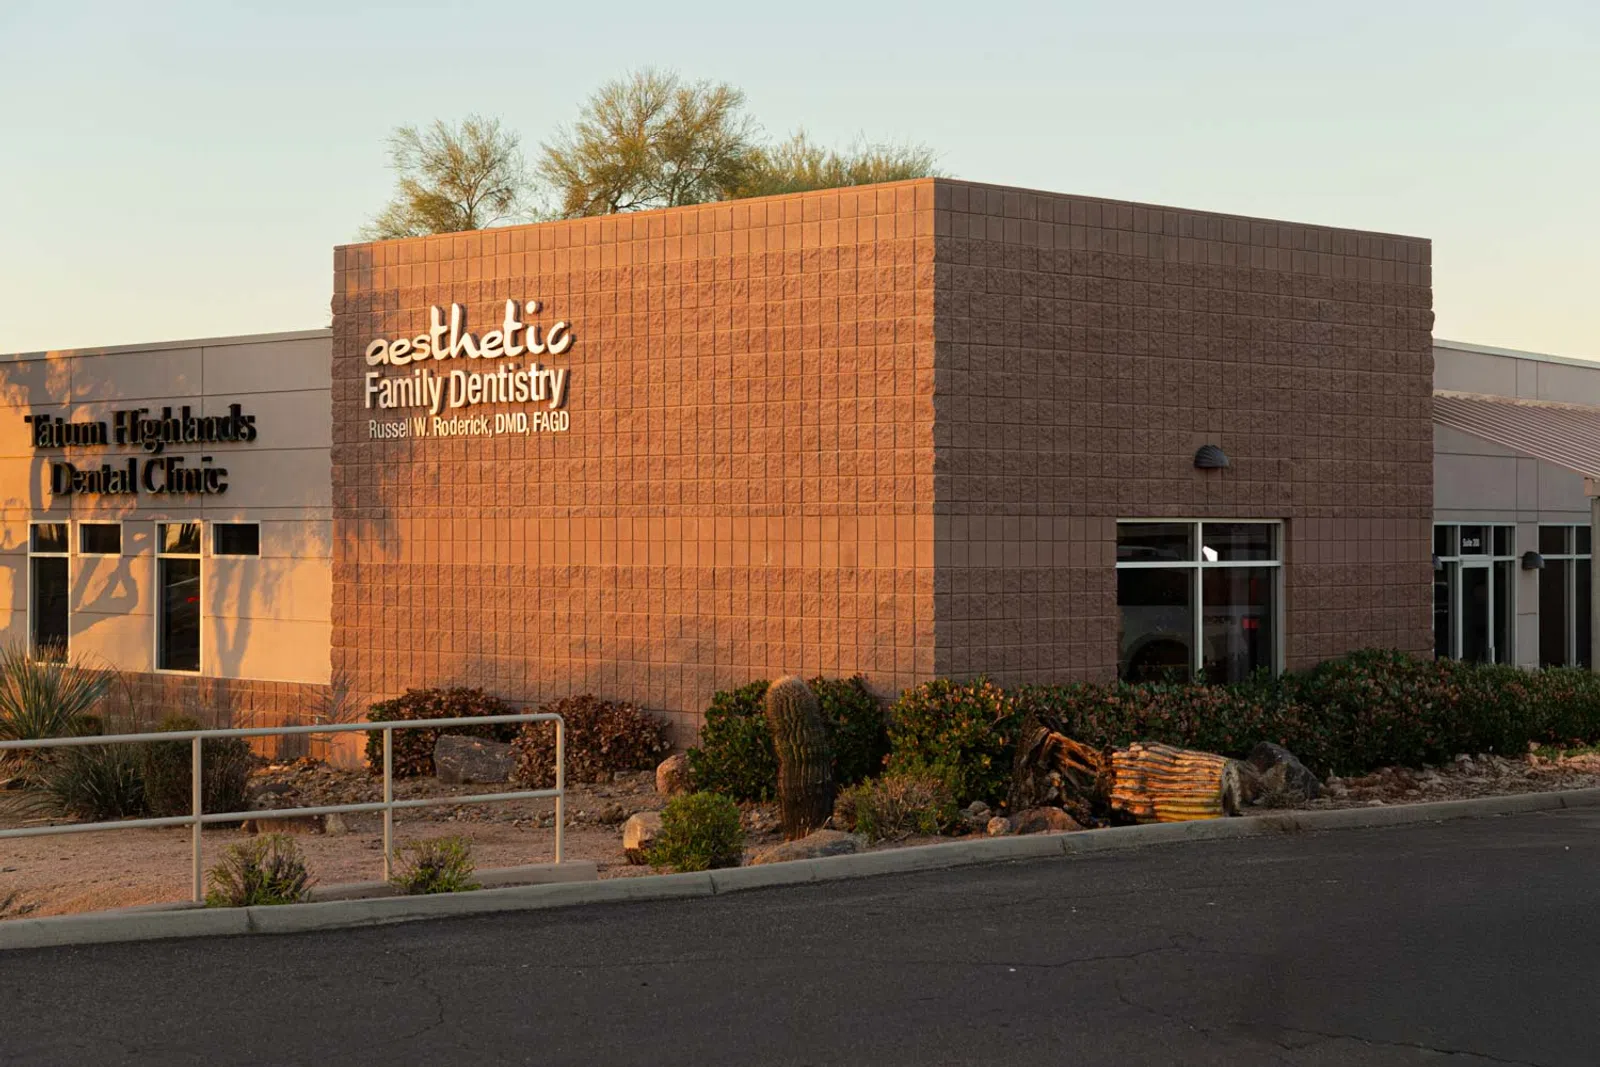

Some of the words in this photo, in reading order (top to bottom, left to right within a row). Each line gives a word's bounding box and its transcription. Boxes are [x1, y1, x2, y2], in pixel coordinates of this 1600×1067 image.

[365, 299, 572, 366] aesthetic
[365, 368, 444, 415] Family
[450, 362, 565, 409] Dentistry
[25, 413, 108, 448] Tatum
[112, 403, 257, 453] Highlands
[369, 419, 412, 438] Russell
[414, 417, 430, 437] W.
[433, 415, 493, 438] Roderick,
[495, 412, 530, 436] DMD,
[533, 410, 570, 432] FAGD
[49, 457, 139, 495] Dental
[142, 456, 229, 495] Clinic
